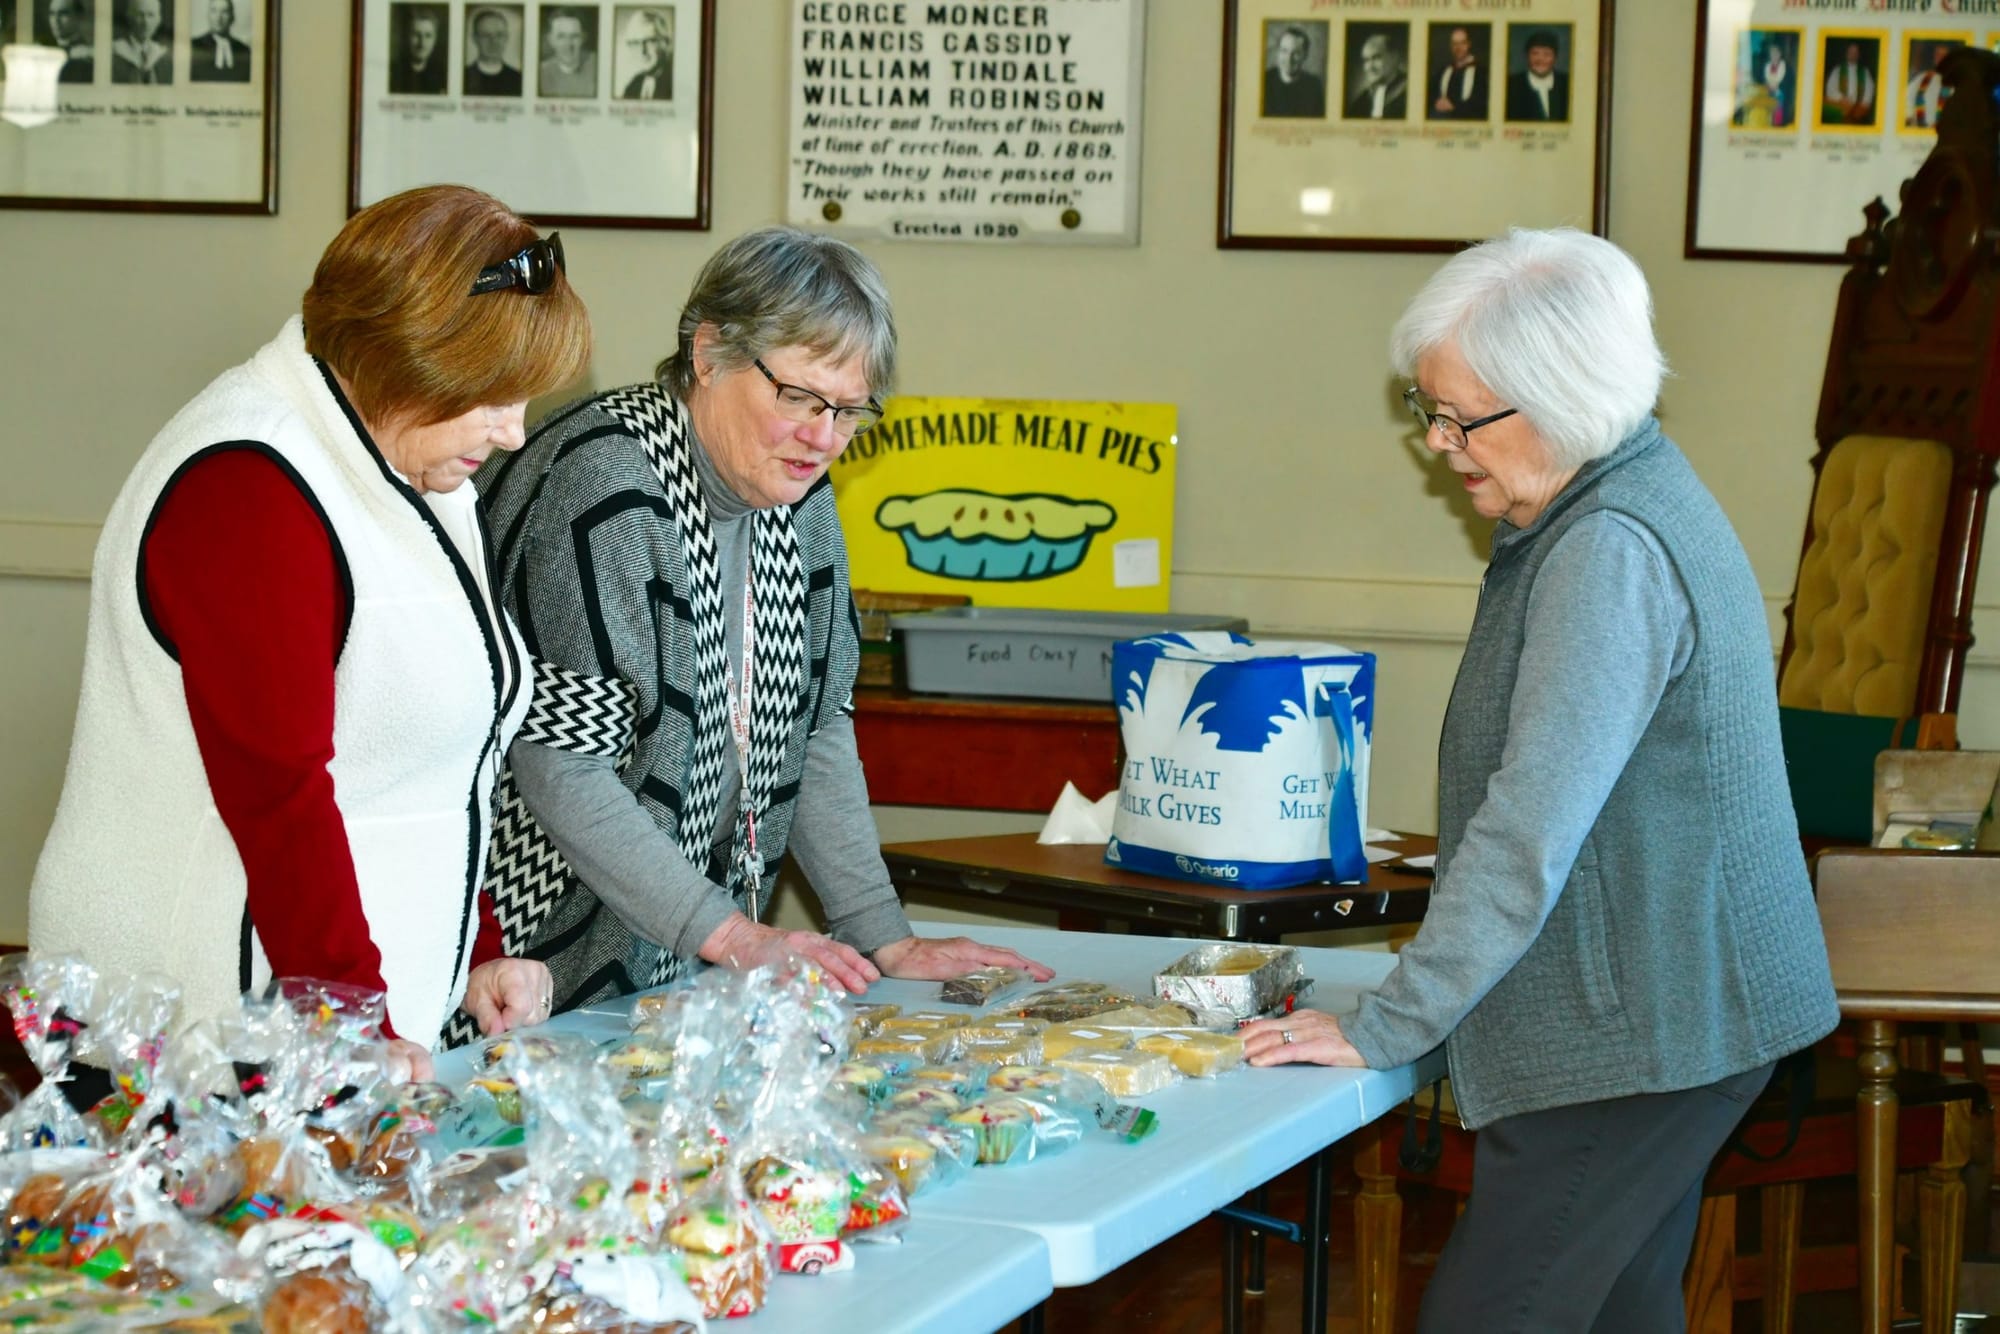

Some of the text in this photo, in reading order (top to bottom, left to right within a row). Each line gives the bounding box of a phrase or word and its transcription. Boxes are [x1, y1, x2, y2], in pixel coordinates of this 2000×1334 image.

[802, 2, 906, 26] GEORGE
[802, 29, 1071, 56] FRANCIS CASSIDY
[803, 57, 1077, 84] WILLIAM TINDALE
[802, 85, 1104, 111] WILLIAM ROBINSON
[802, 114, 1125, 136] Minister and Trustees of this Church
[801, 137, 820, 153] at
[825, 138, 863, 153] time
[870, 138, 893, 154] of
[882, 162, 931, 182] they
[941, 166, 993, 181] have
[1000, 168, 1075, 184] passed
[1084, 172, 1113, 183] on
[801, 183, 851, 200] Their
[863, 189, 926, 202] works
[938, 189, 977, 203] still
[894, 221, 1019, 238] Erected 1920
[1014, 413, 1091, 455] MEAT
[1098, 426, 1165, 475] PIES
[967, 643, 1012, 663] Food
[1126, 756, 1221, 790] ET WHAT
[1283, 774, 1320, 794] GET
[1158, 793, 1221, 826] GIVES
[1280, 800, 1328, 820] MILK
[1192, 861, 1239, 881] Ontario
